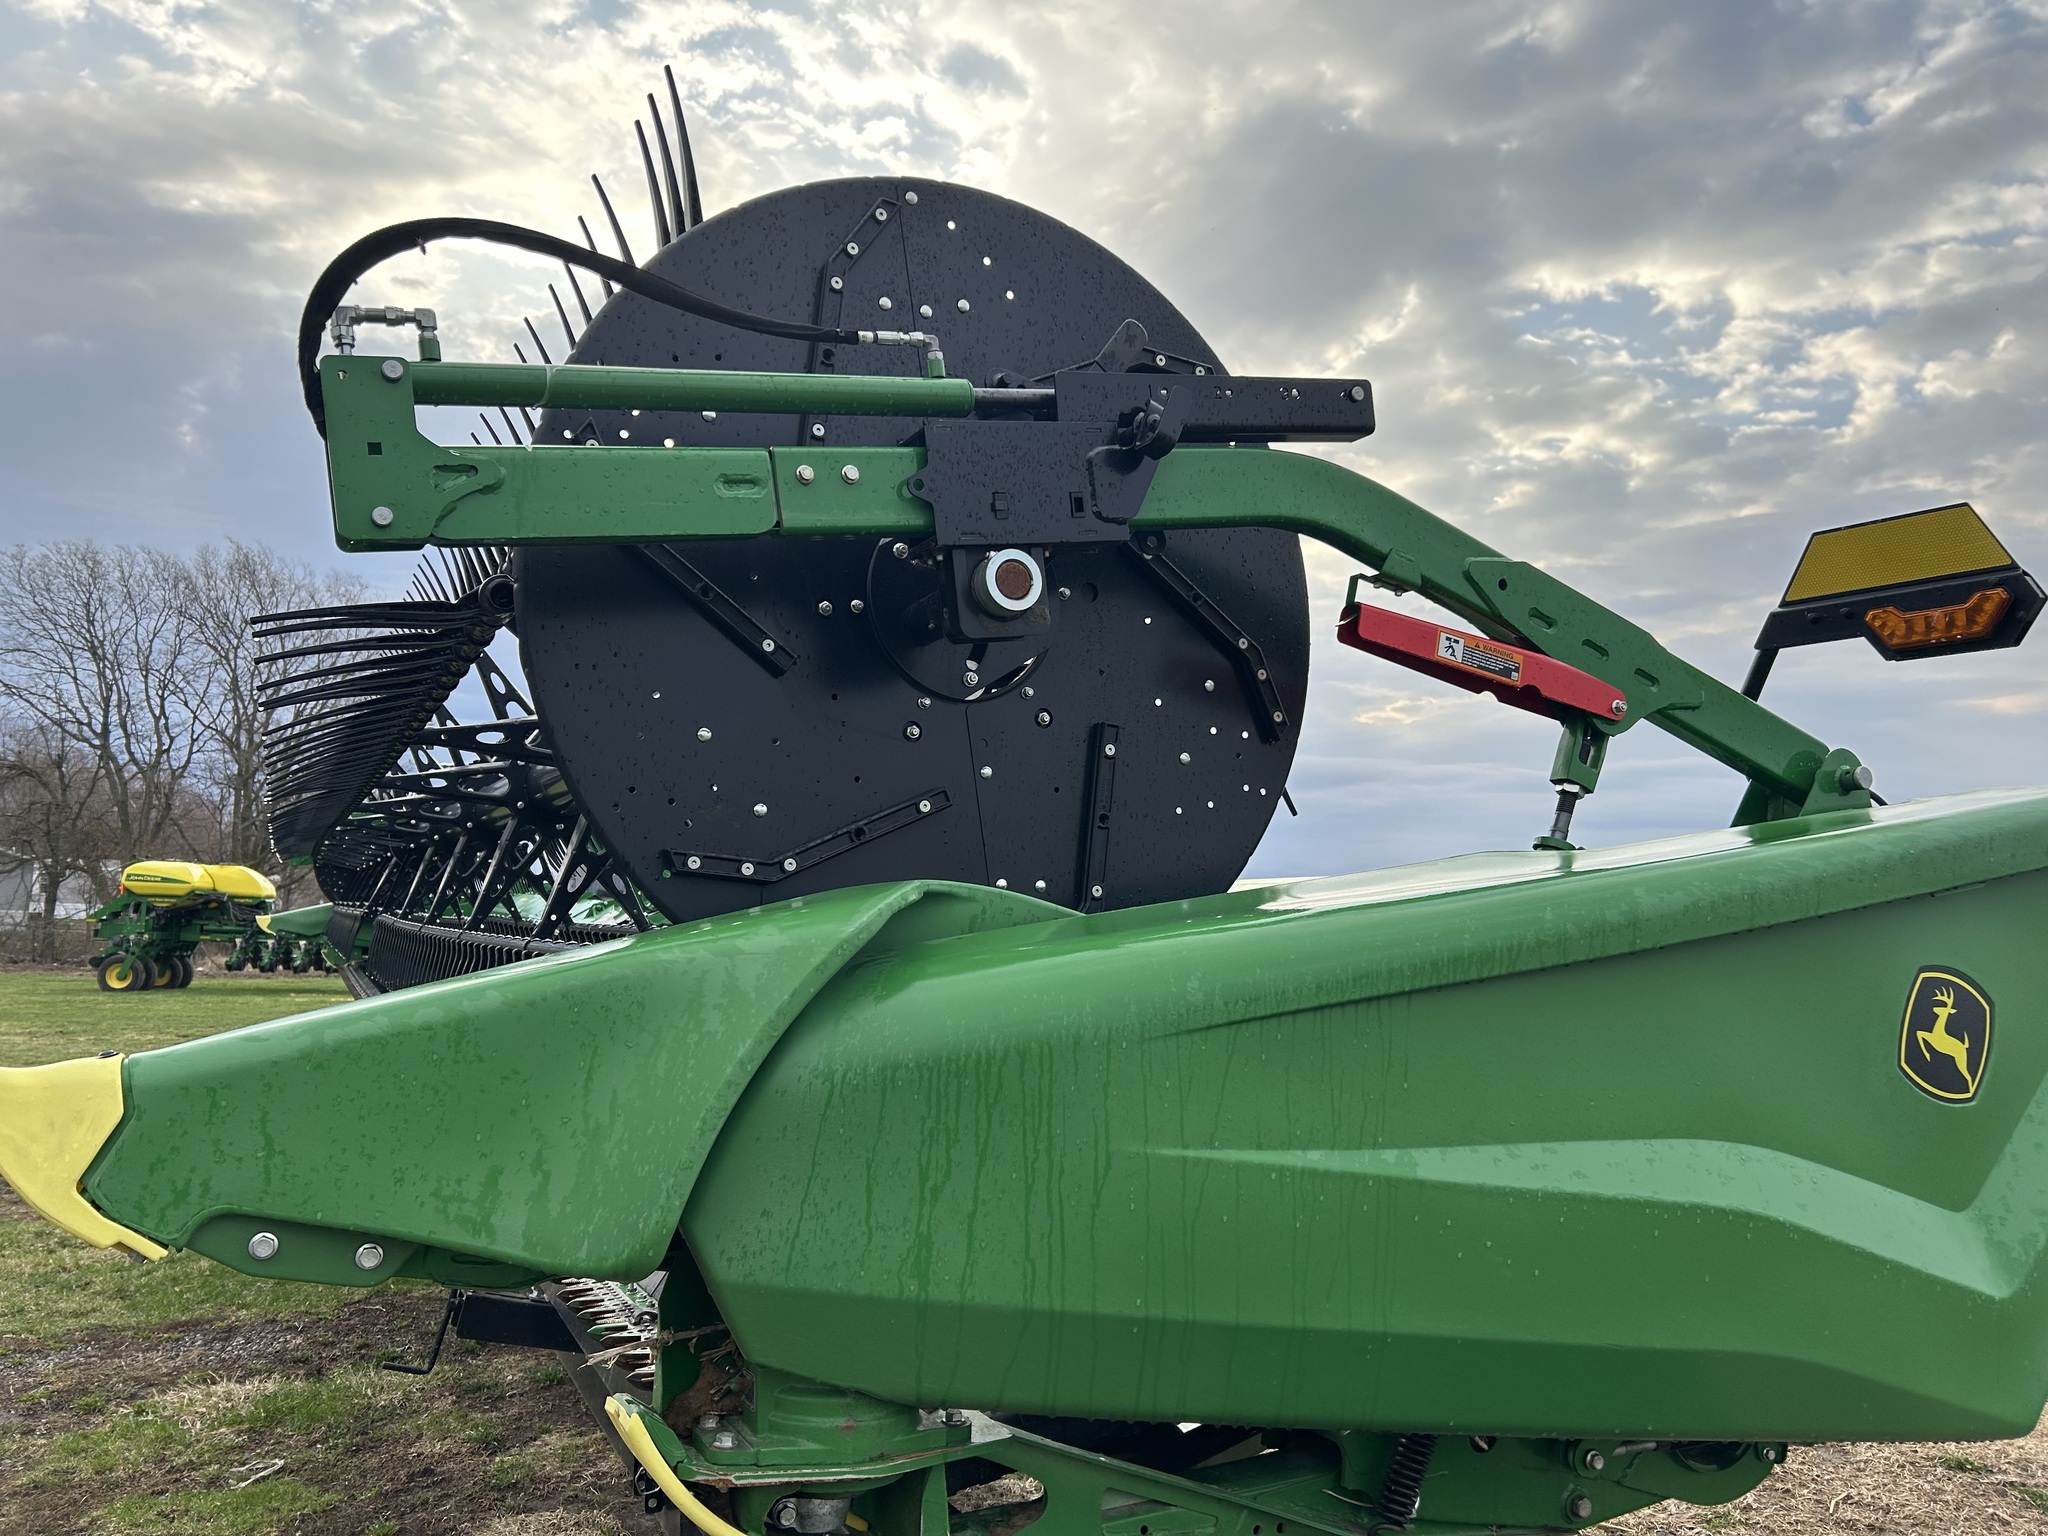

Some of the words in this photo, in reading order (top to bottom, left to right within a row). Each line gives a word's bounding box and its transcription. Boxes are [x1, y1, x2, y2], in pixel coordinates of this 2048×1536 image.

[1213, 386, 1222, 399] 2
[1280, 387, 1289, 400] 3
[1339, 389, 1348, 401] 4
[1482, 644, 1514, 660] WARNING
